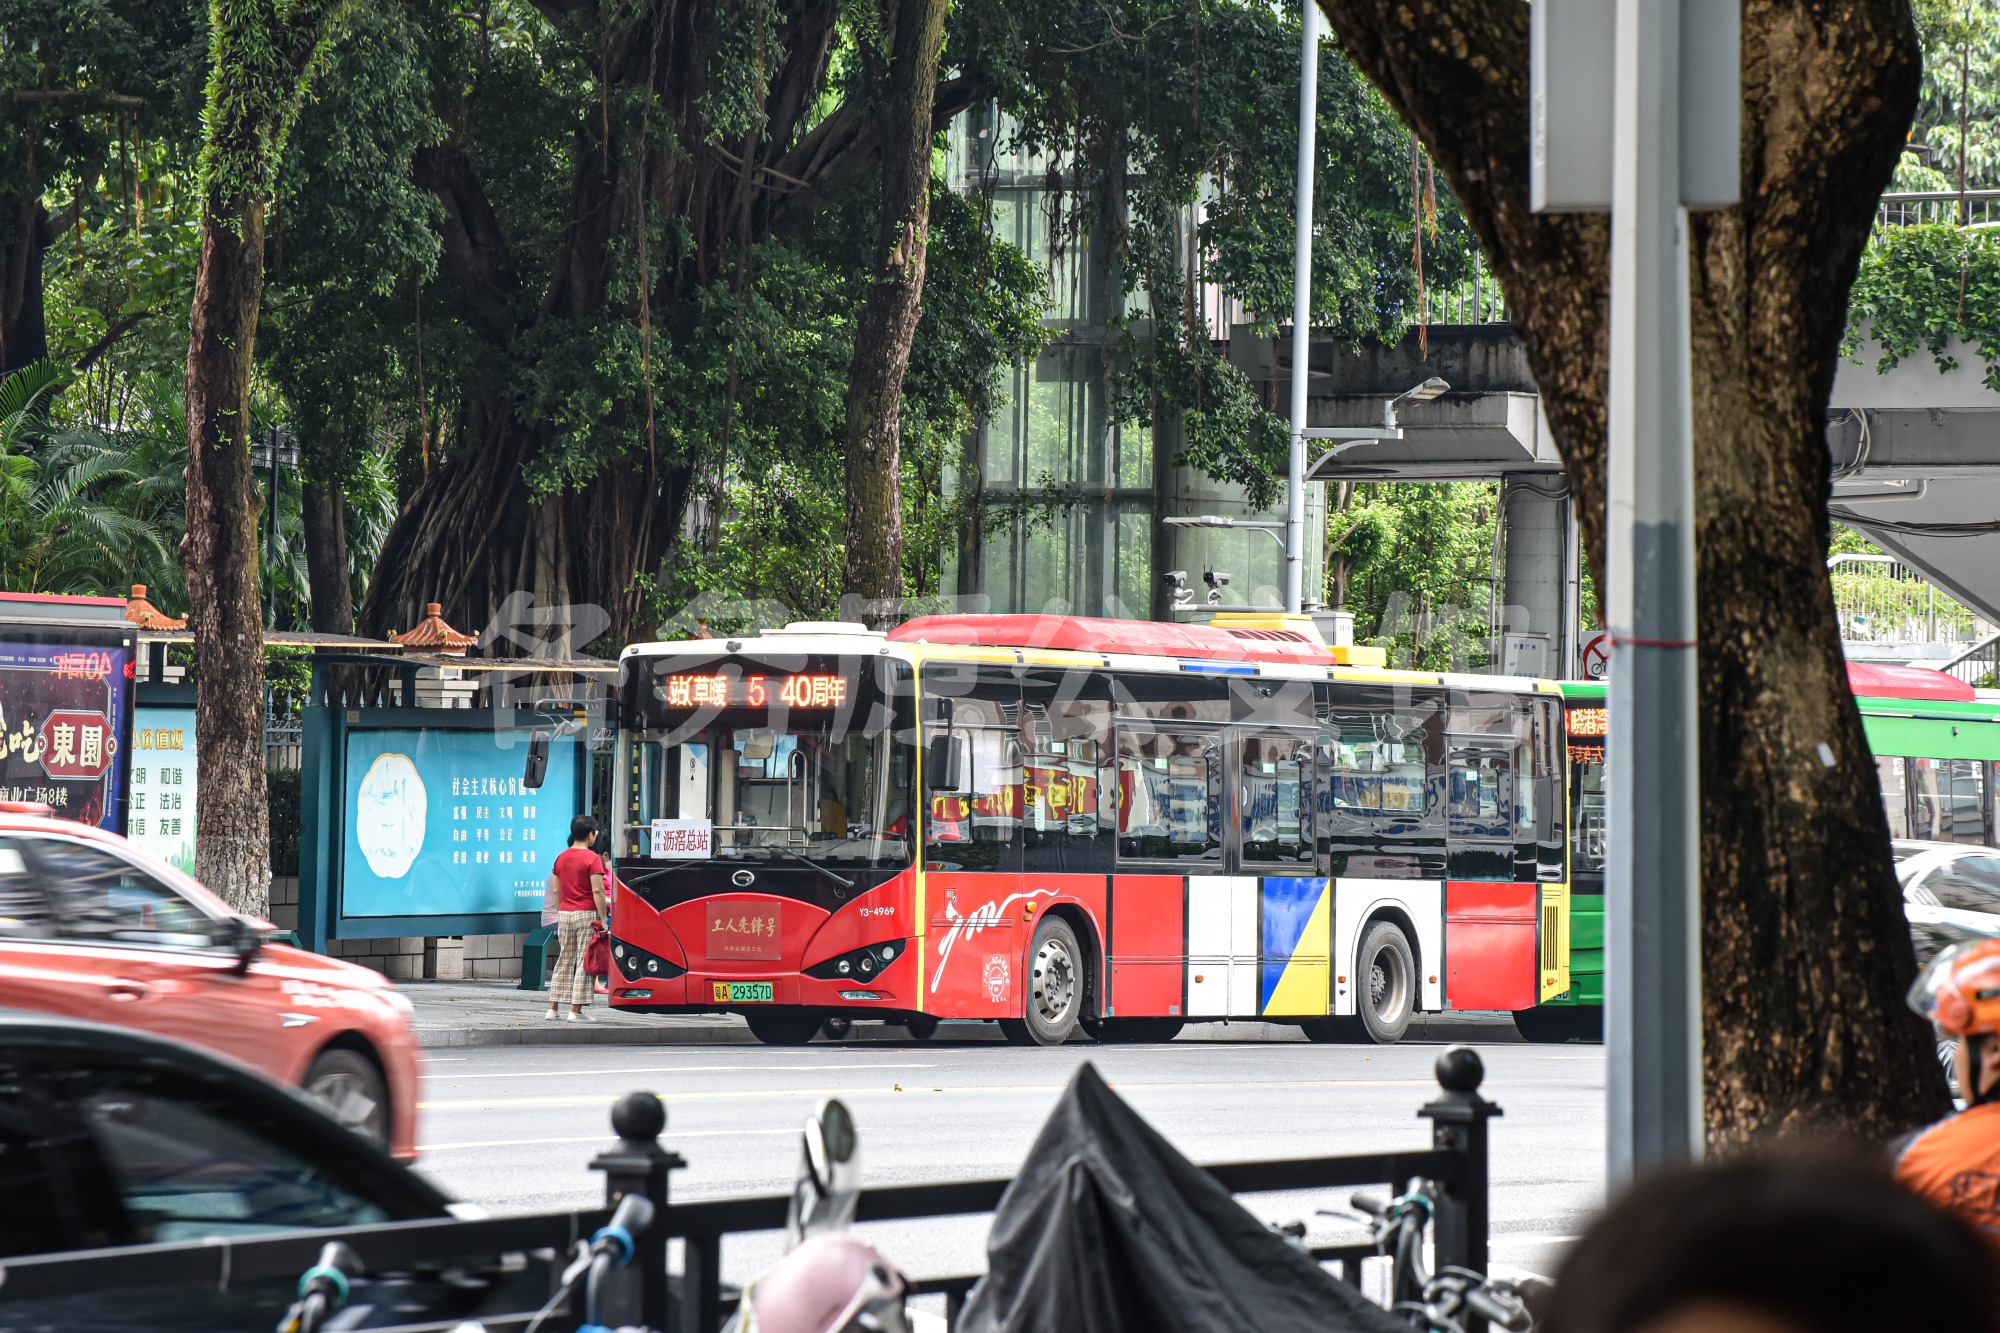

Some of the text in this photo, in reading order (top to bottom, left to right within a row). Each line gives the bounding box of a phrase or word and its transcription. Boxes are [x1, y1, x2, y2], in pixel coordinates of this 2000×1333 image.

[748, 675, 765, 706] 5
[781, 676, 846, 707] 40周年
[160, 767, 183, 785] 和谐
[160, 792, 182, 810] 法治
[453, 806, 468, 820] 富强
[476, 806, 489, 819] 民主
[499, 806, 513, 819] 文明
[159, 818, 182, 836] 友善
[453, 828, 536, 842] 自由 平等 公正 法治
[663, 829, 709, 852] 沥滘总站
[453, 851, 467, 864] 爱国
[522, 850, 536, 863] 友善
[859, 907, 895, 917] Y3-4969
